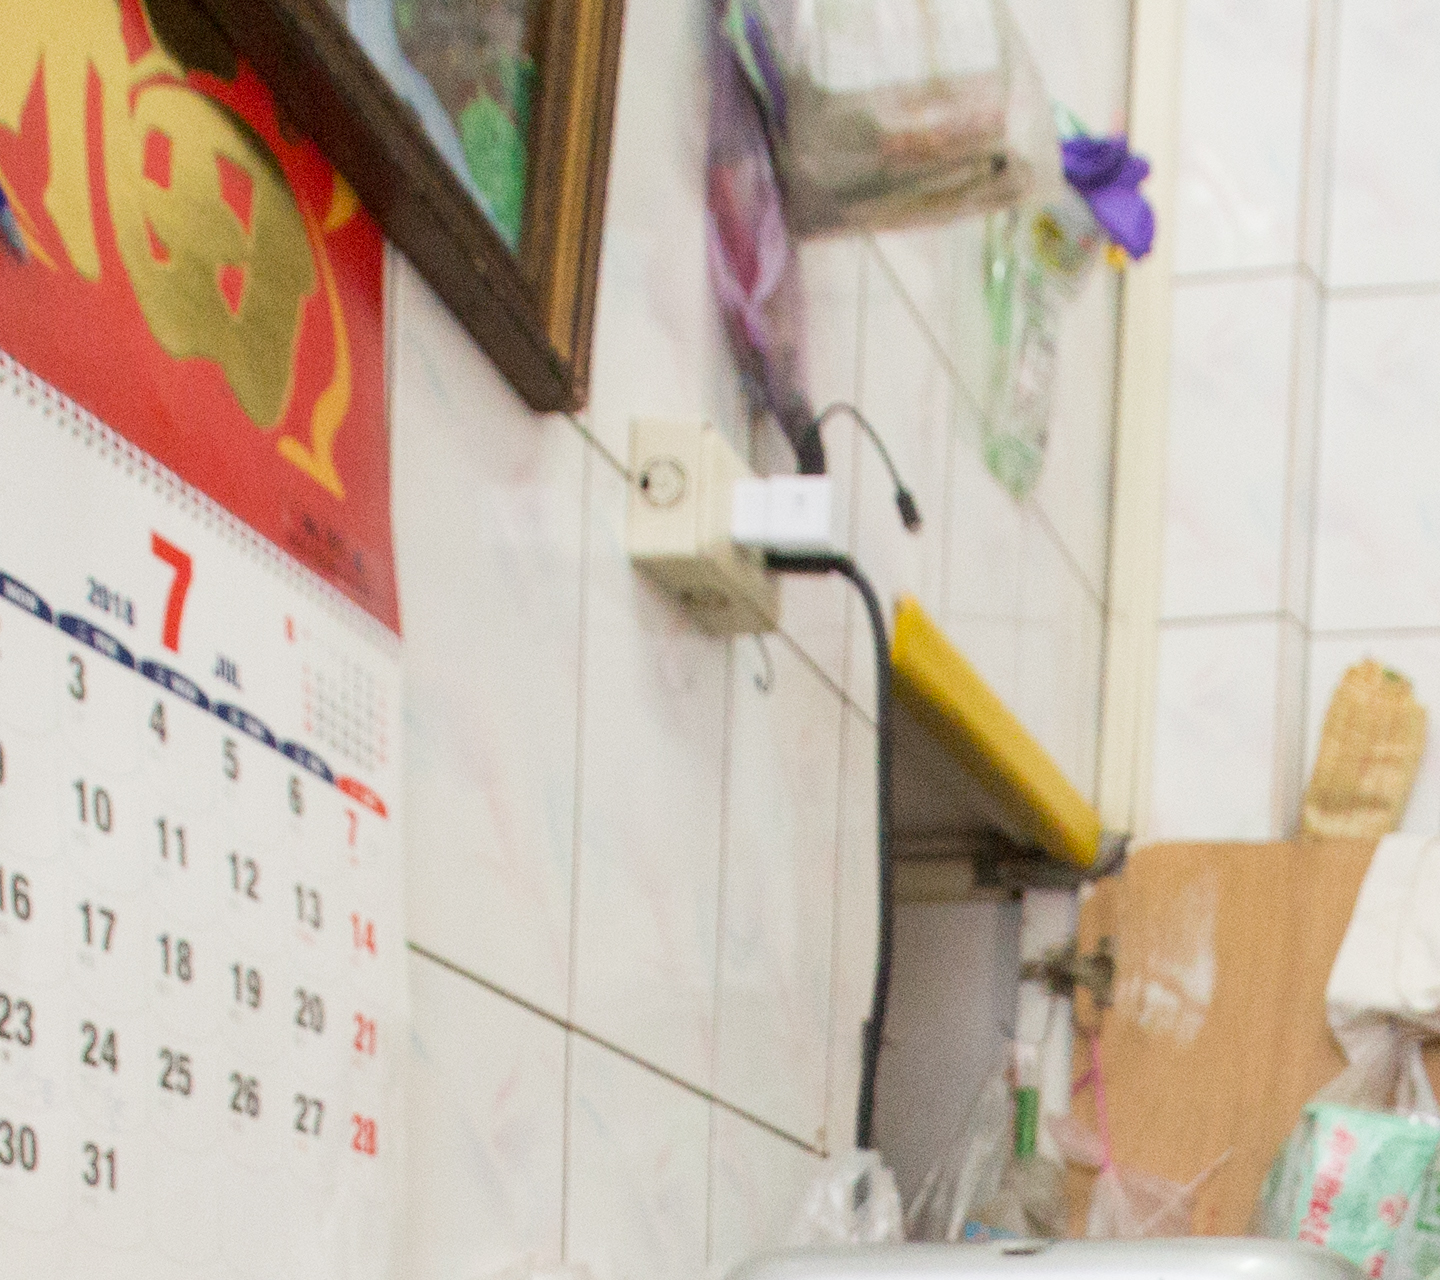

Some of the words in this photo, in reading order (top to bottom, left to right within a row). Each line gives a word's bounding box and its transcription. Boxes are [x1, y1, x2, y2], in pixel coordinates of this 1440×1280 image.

[151, 533, 193, 652] 7
[68, 654, 87, 702] 3
[149, 702, 166, 742] 4
[223, 738, 240, 781] 5
[345, 809, 357, 845] 7
[73, 779, 113, 834] 10
[156, 817, 187, 867] 11
[228, 852, 259, 901] 12
[295, 885, 322, 930] 13
[351, 914, 376, 954] 14
[79, 902, 117, 951] 17
[158, 934, 193, 983] 18
[231, 964, 262, 1009] 19
[295, 988, 325, 1034] 20
[82, 1022, 118, 1072] 24
[159, 1048, 192, 1096] 25
[230, 1072, 260, 1118] 26
[295, 1094, 325, 1135] 27
[83, 1142, 116, 1190] 31
